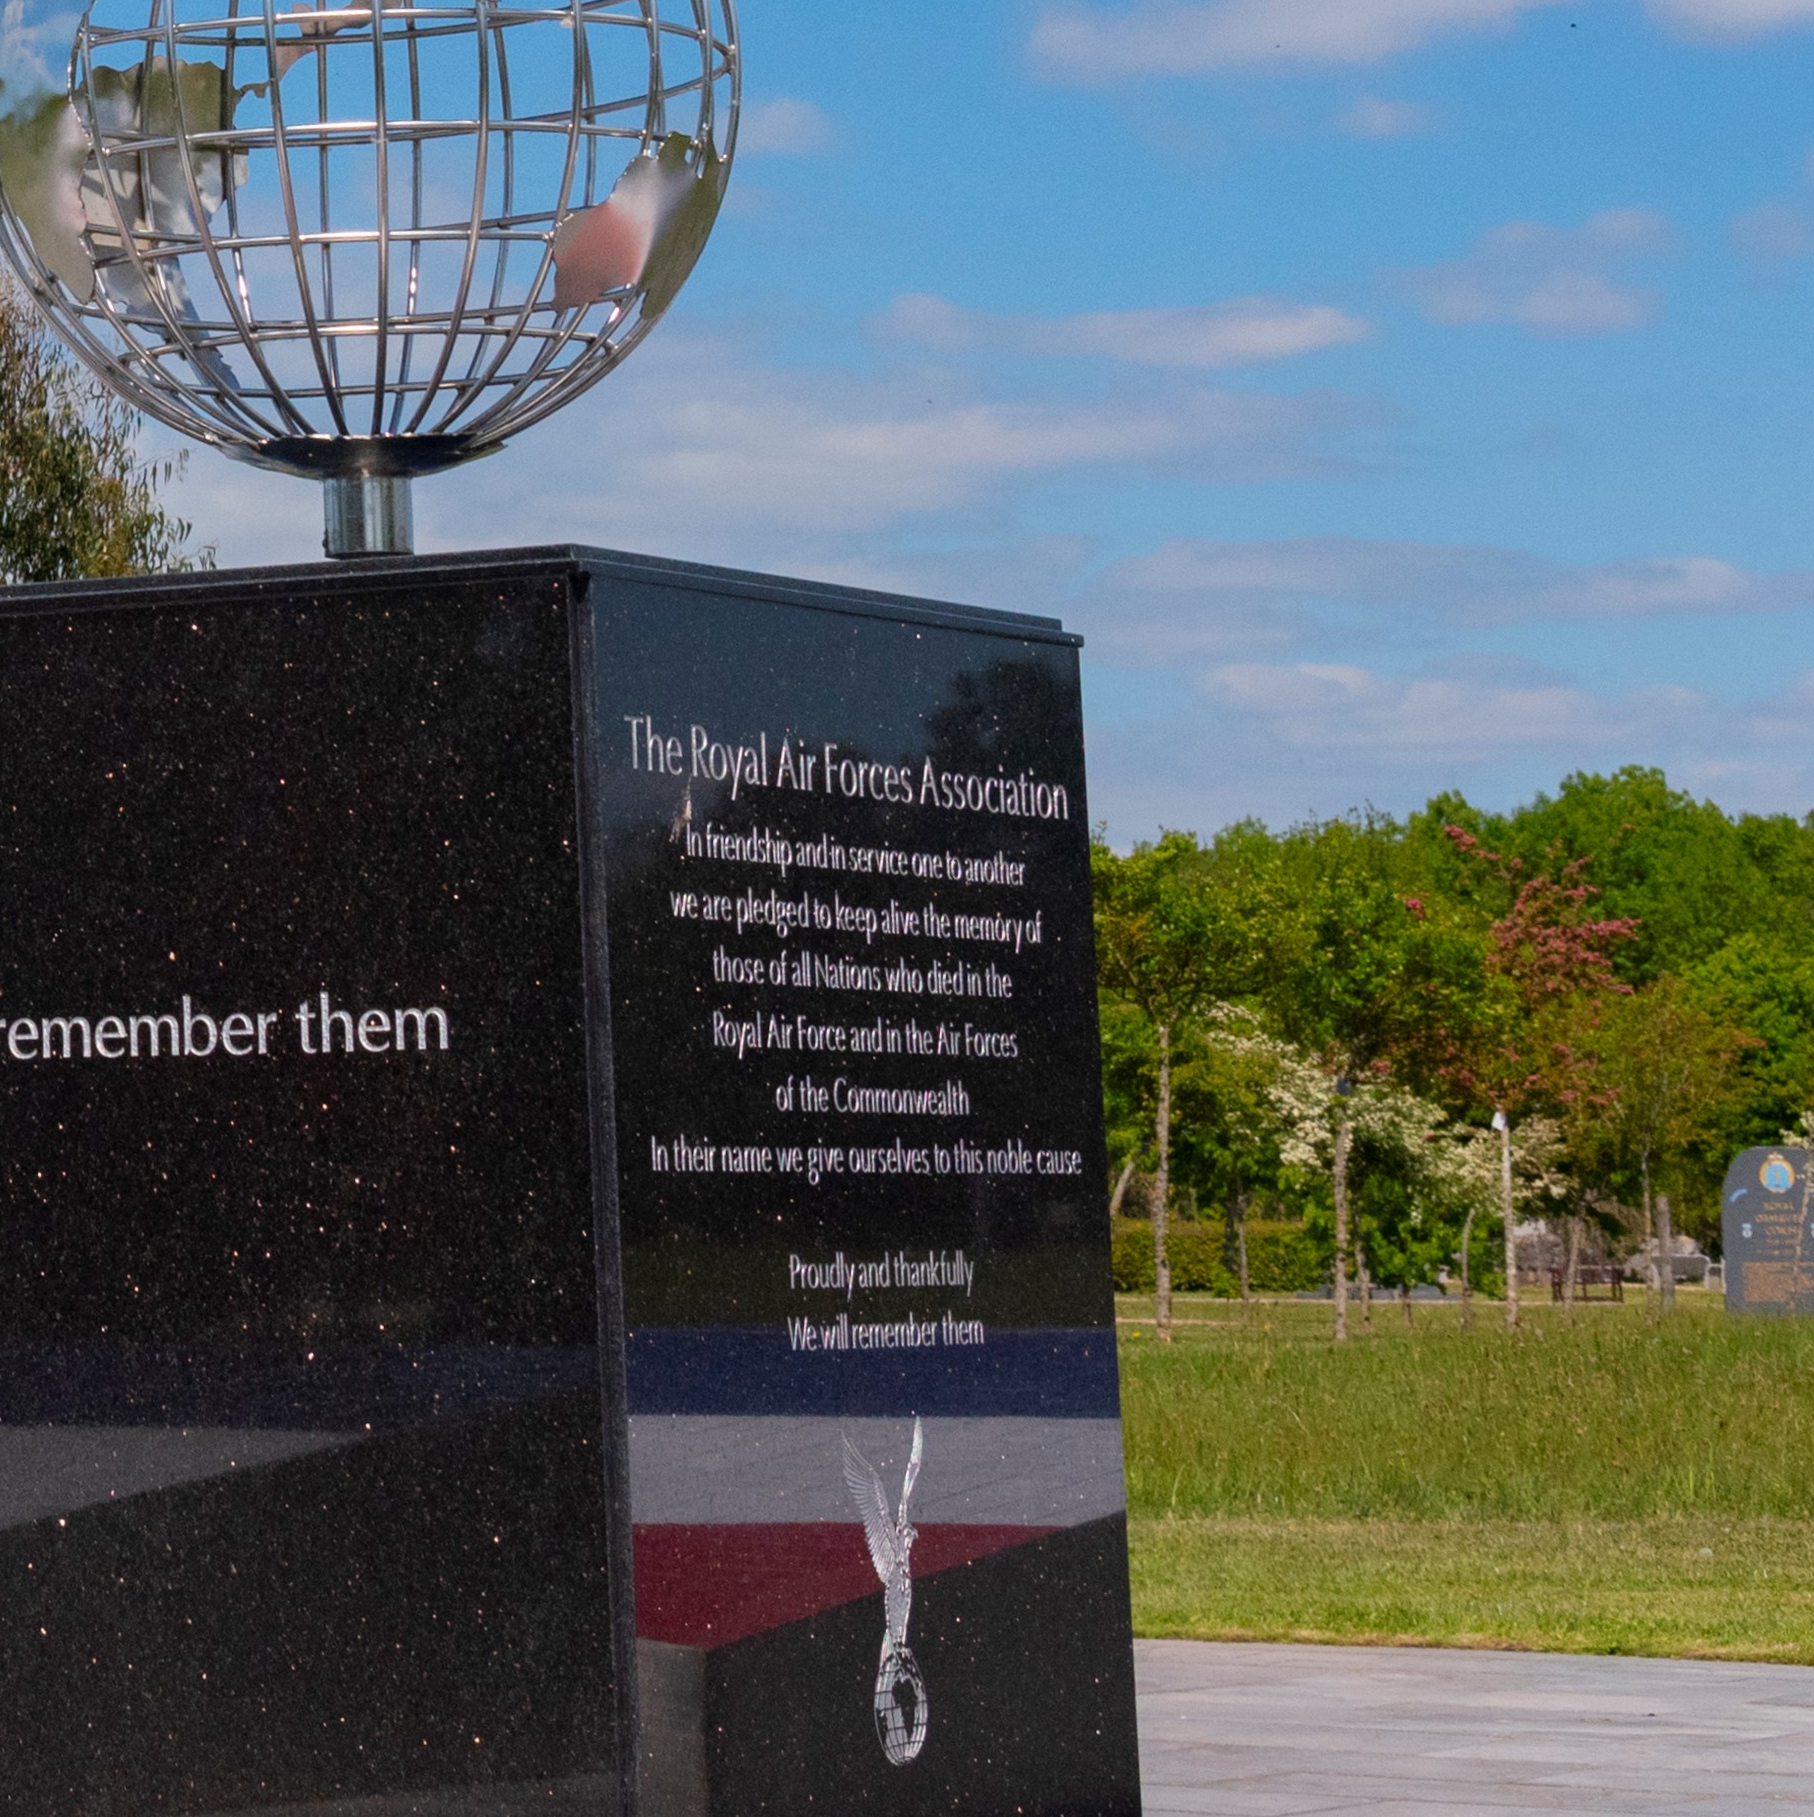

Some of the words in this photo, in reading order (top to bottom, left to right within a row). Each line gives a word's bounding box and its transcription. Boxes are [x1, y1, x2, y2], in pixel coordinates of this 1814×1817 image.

[624, 715, 682, 774] The
[691, 724, 768, 801] Royal
[776, 736, 816, 793] Air
[824, 743, 913, 804] Forces
[920, 757, 1069, 820] Association
[685, 822, 702, 857] In
[706, 822, 793, 877] friendship
[796, 834, 827, 869] and
[829, 837, 847, 870] in
[849, 843, 908, 875] service
[911, 850, 943, 878] one
[945, 851, 962, 881] to
[965, 850, 1025, 885] another
[670, 892, 699, 918] we
[703, 894, 732, 922] are
[736, 888, 809, 937] pledged
[814, 900, 831, 930] to
[835, 891, 877, 944] keep
[881, 902, 920, 936] alive
[923, 900, 951, 939] the
[954, 911, 1023, 954] memory
[1025, 911, 1042, 944] of
[712, 946, 764, 985] those
[769, 950, 787, 986] of
[791, 951, 811, 988] all
[815, 955, 881, 991] Nations
[884, 959, 923, 994] who
[927, 959, 964, 995] died
[967, 964, 982, 997] in
[984, 964, 1012, 999] the
[295, 991, 448, 1054] them
[713, 1011, 762, 1059] Royal
[767, 1015, 793, 1049] Air
[797, 1015, 845, 1051] Force
[850, 1017, 881, 1052] and
[886, 1020, 902, 1054] in
[906, 1020, 933, 1055] the
[937, 1020, 960, 1056] Air
[965, 1023, 1018, 1058] Forces
[775, 1074, 795, 1112] of
[799, 1077, 828, 1112] the
[833, 1077, 970, 1116] Commonwealth
[650, 1136, 668, 1171] In
[674, 1133, 716, 1173] their
[721, 1144, 772, 1173] name
[776, 1147, 803, 1173] we
[807, 1139, 844, 1185] give
[849, 1138, 930, 1174] ourselves
[933, 1144, 950, 1174] to
[954, 1140, 983, 1175] this
[986, 1139, 1032, 1175] noble
[1037, 1149, 1082, 1175] cause
[790, 1252, 854, 1303] Proudly
[858, 1252, 889, 1288] and
[894, 1251, 974, 1296] thankfully
[787, 1317, 817, 1351] We
[819, 1314, 849, 1350] will
[852, 1312, 937, 1349] remember
[942, 1311, 984, 1346] them
